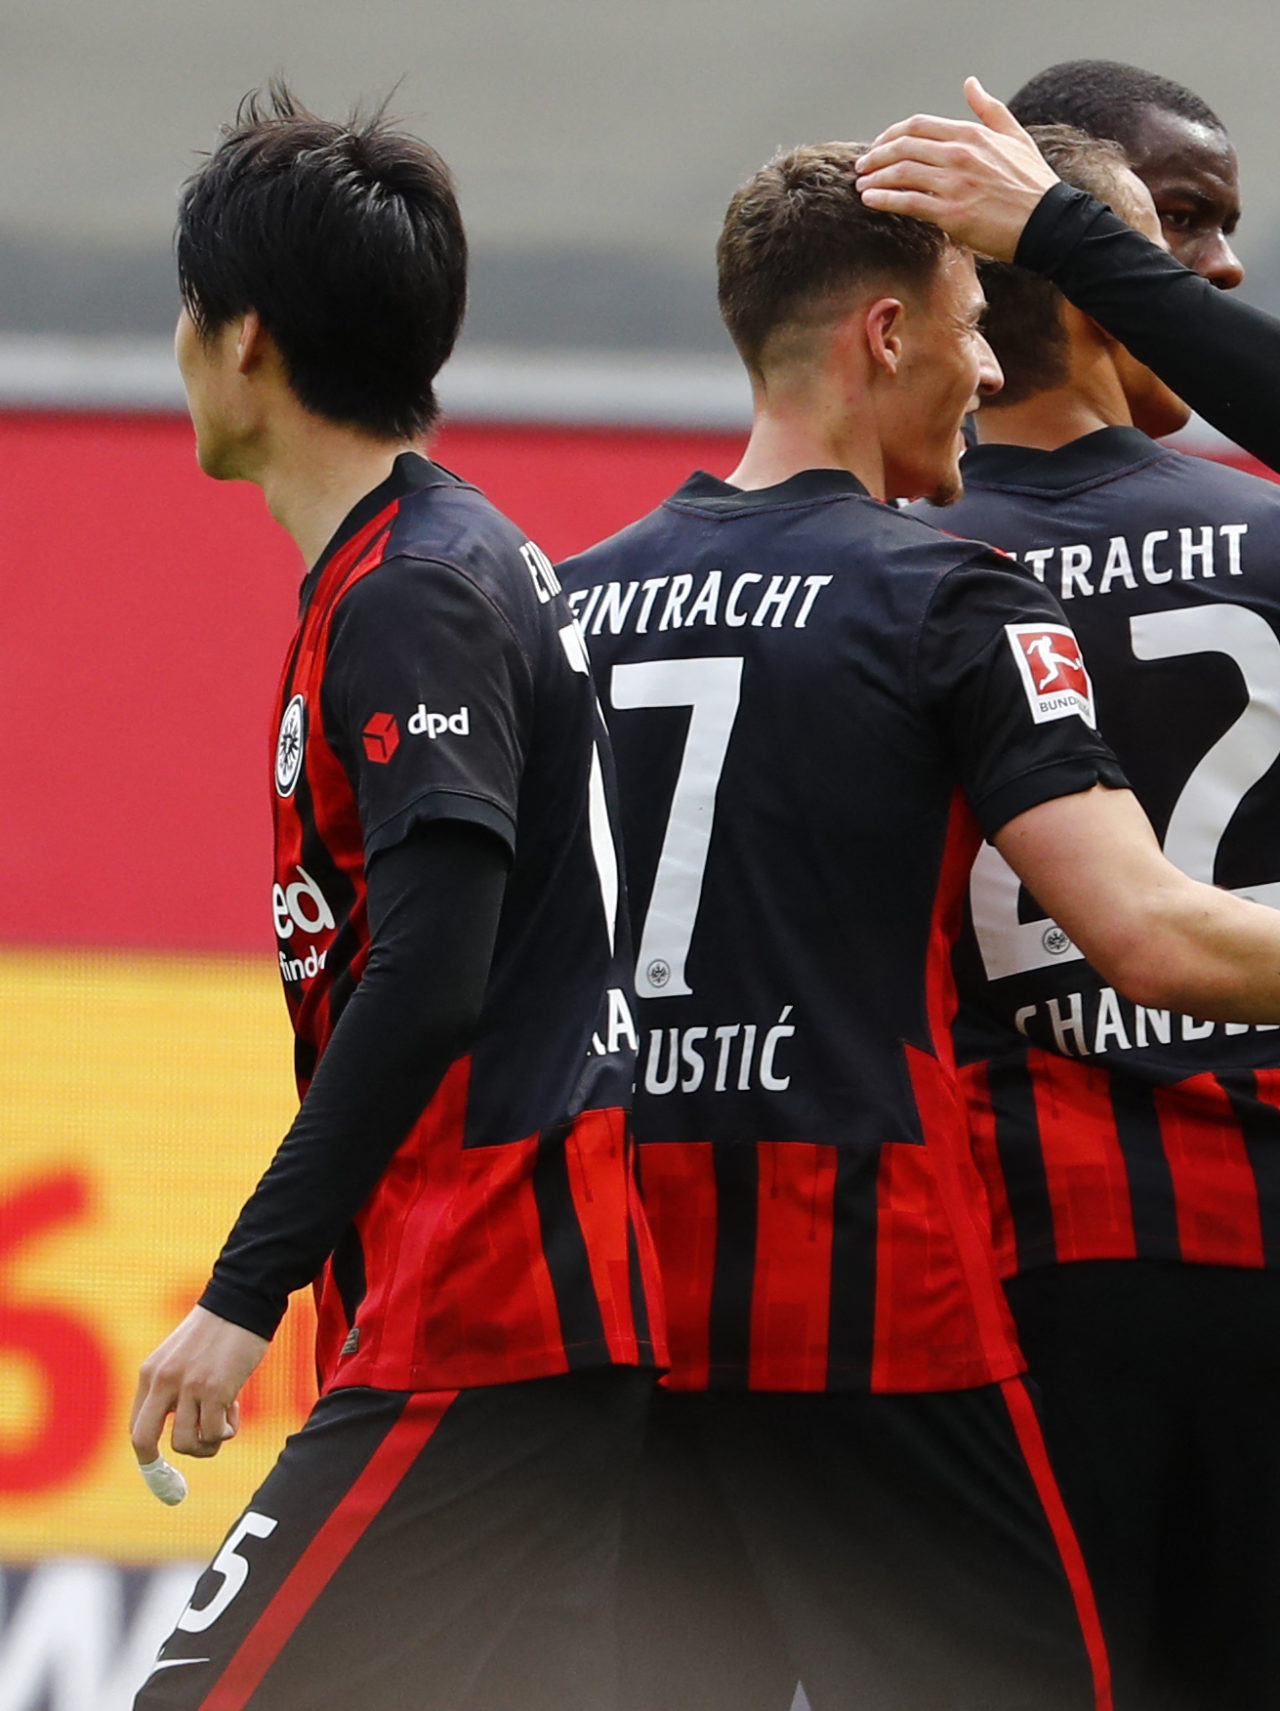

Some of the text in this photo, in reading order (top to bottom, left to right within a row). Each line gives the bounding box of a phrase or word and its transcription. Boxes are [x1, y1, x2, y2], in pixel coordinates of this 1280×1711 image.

[1008, 523, 1248, 601] TRACHT
[407, 703, 470, 740] dpd
[610, 656, 744, 998] 7
[634, 1004, 796, 1095] USTIĆ
